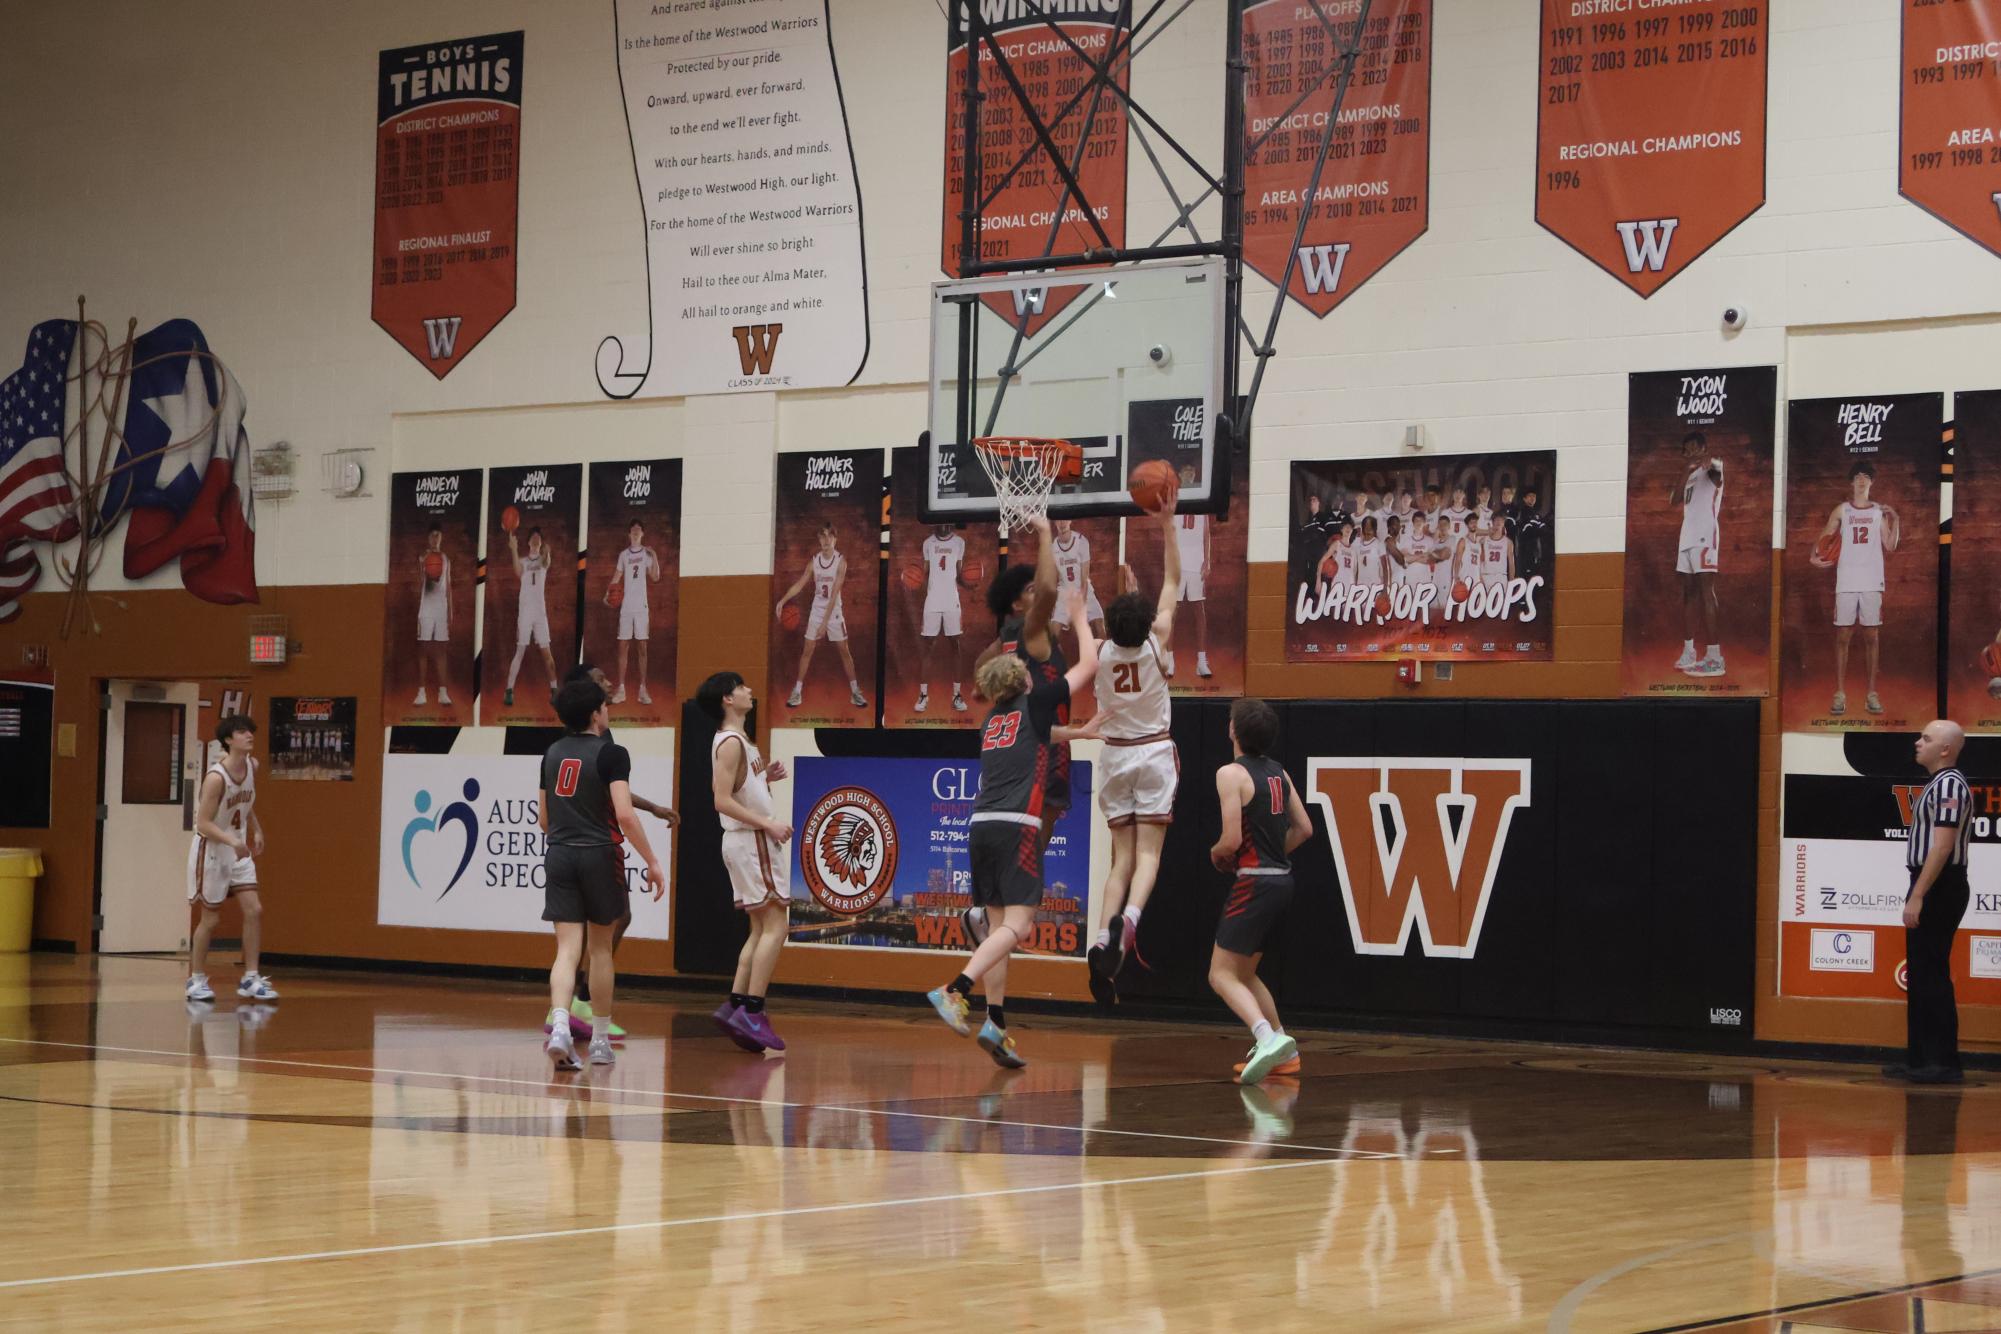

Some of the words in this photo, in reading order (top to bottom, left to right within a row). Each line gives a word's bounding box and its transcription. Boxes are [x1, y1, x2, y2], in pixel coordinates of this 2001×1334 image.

[651, 4, 671, 16] And
[1295, 0, 1362, 20] PLAYOFFS
[1571, 0, 1633, 17] DISTRICT
[624, 38, 633, 50] Is
[635, 35, 651, 48] the
[653, 33, 680, 47] home
[682, 30, 695, 44] of
[696, 30, 712, 42] the
[715, 22, 768, 38] Westwood
[771, 17, 819, 32] Warriors
[1300, 25, 1325, 40] 1986
[1551, 27, 1584, 48] 1991
[1592, 22, 1626, 44] 1996
[1634, 17, 1670, 40] 1997
[1679, 12, 1714, 34] 1999
[1721, 8, 1758, 28] 2000
[426, 44, 475, 64] BOYS
[1268, 46, 1293, 62] 1997
[1299, 42, 1324, 58] 1998
[1363, 34, 1389, 51] 2000
[1550, 55, 1584, 76] 2002
[1591, 51, 1626, 72] 2003
[1634, 46, 1669, 68] 2014
[1678, 41, 1713, 64] 2015
[1720, 37, 1757, 59] 2016
[667, 58, 715, 75] Protected
[717, 56, 730, 71] by
[732, 58, 749, 68] our
[1266, 64, 1292, 78] 2003
[1912, 66, 1945, 85] 1993
[1952, 61, 1984, 81] 1997
[390, 58, 510, 106] TENNIS
[736, 86, 758, 98] ever
[1266, 80, 1292, 96] 2020
[1362, 68, 1388, 86] 2023
[1548, 83, 1582, 104] 2017
[396, 118, 437, 134] DISTRICT
[438, 109, 500, 128] CHAMPIONS
[670, 125, 680, 135] to
[682, 123, 698, 134] the
[700, 121, 719, 132] end
[748, 114, 770, 126] ever
[985, 108, 1012, 124] 2003
[1252, 114, 1309, 132] DISTRICT
[985, 130, 1012, 147] 2008
[1297, 129, 1322, 145] 1986
[1360, 121, 1386, 137] 1999
[1392, 118, 1420, 136] 2000
[1947, 128, 1994, 147] AREA
[984, 152, 1012, 170] 2014
[1088, 140, 1117, 158] 2017
[1264, 149, 1290, 166] 2003
[1328, 144, 1354, 160] 2021
[1360, 139, 1387, 156] 2023
[1560, 140, 1638, 160] REGIONAL
[1642, 130, 1742, 154] CHAMPIONS
[655, 157, 678, 169] With
[681, 157, 698, 167] our
[773, 144, 794, 157] and
[1912, 152, 1944, 171] 1997
[1950, 149, 1983, 168] 1998
[658, 188, 690, 202] pledge
[692, 187, 702, 196] to
[705, 178, 757, 194] Westwood
[790, 176, 810, 187] our
[1018, 169, 1045, 188] 2021
[1547, 170, 1580, 192] 1996
[1260, 190, 1297, 207] AREA
[650, 219, 667, 231] For
[668, 218, 684, 230] the
[687, 216, 714, 228] home
[716, 212, 728, 225] of
[729, 210, 746, 224] the
[749, 207, 801, 222] Westwood
[805, 202, 854, 216] Warriors
[1264, 208, 1288, 224] 1994
[1358, 200, 1385, 216] 2014
[1392, 196, 1418, 214] 2021
[399, 235, 449, 251] REGIONAL
[451, 230, 492, 246] FINALIST
[690, 246, 710, 257] Will
[712, 246, 734, 256] ever
[737, 243, 764, 254] shine
[768, 242, 778, 251] so
[983, 240, 1009, 258] 2021
[1616, 217, 1680, 273] W
[682, 276, 702, 289] Hail
[705, 278, 716, 286] to
[718, 275, 740, 286] thee
[742, 275, 760, 284] our
[762, 270, 790, 283] Alma
[1298, 243, 1351, 294] W
[681, 307, 696, 320] All
[698, 305, 717, 318] hail
[720, 306, 730, 316] to
[732, 303, 768, 317] orange
[770, 299, 790, 311] and
[422, 316, 462, 360] W
[732, 322, 783, 376] W
[727, 377, 754, 388] CLASS
[1681, 374, 1726, 396] TYSON
[1174, 405, 1204, 422] COLE
[1677, 394, 1728, 417] WOODS
[1838, 402, 1894, 424] HENRY
[1844, 422, 1882, 446] BELL
[624, 465, 651, 482] JOHN
[805, 455, 854, 474] SUMNER
[416, 474, 460, 492] LANDEYN
[522, 470, 548, 487] JOHN
[804, 471, 854, 490] HOLLAND
[416, 491, 460, 508] VALLERY
[514, 486, 555, 504] MCNAIR
[1852, 526, 1868, 544] 12
[1444, 576, 1544, 623] HOOPS
[1112, 662, 1142, 694] 21
[982, 710, 1022, 752] 23
[554, 758, 582, 798] 0
[1266, 776, 1284, 815] 11
[231, 808, 242, 830] 4
[804, 792, 845, 845] WESTWOOD
[846, 790, 872, 806] HIGH
[870, 802, 895, 848] SCHOOL
[1306, 756, 1532, 960] W
[1794, 844, 1807, 918] WARRIORS
[820, 887, 877, 910] WARRIORS
[1833, 933, 1852, 954] C
[1814, 957, 1844, 965] COLONY
[1846, 958, 1868, 966] CREEK
[1710, 1008, 1742, 1018] LISCO
